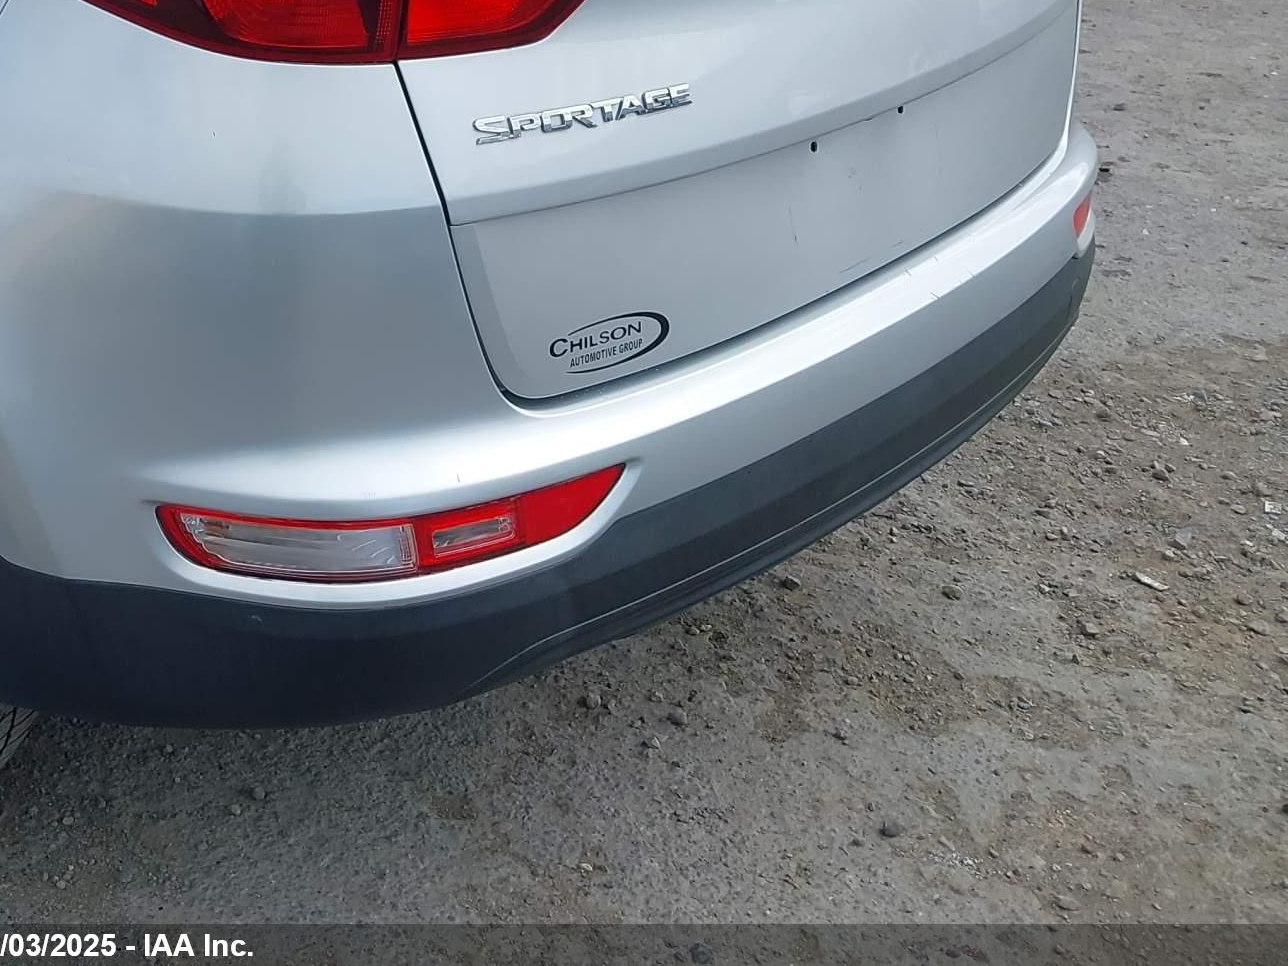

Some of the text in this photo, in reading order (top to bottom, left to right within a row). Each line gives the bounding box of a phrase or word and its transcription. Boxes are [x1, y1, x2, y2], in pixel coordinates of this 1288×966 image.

[473, 82, 692, 145] SPORTAGE
[549, 321, 642, 357] CHILSON
[570, 338, 643, 368] AUTOMOTIVE GROUP
